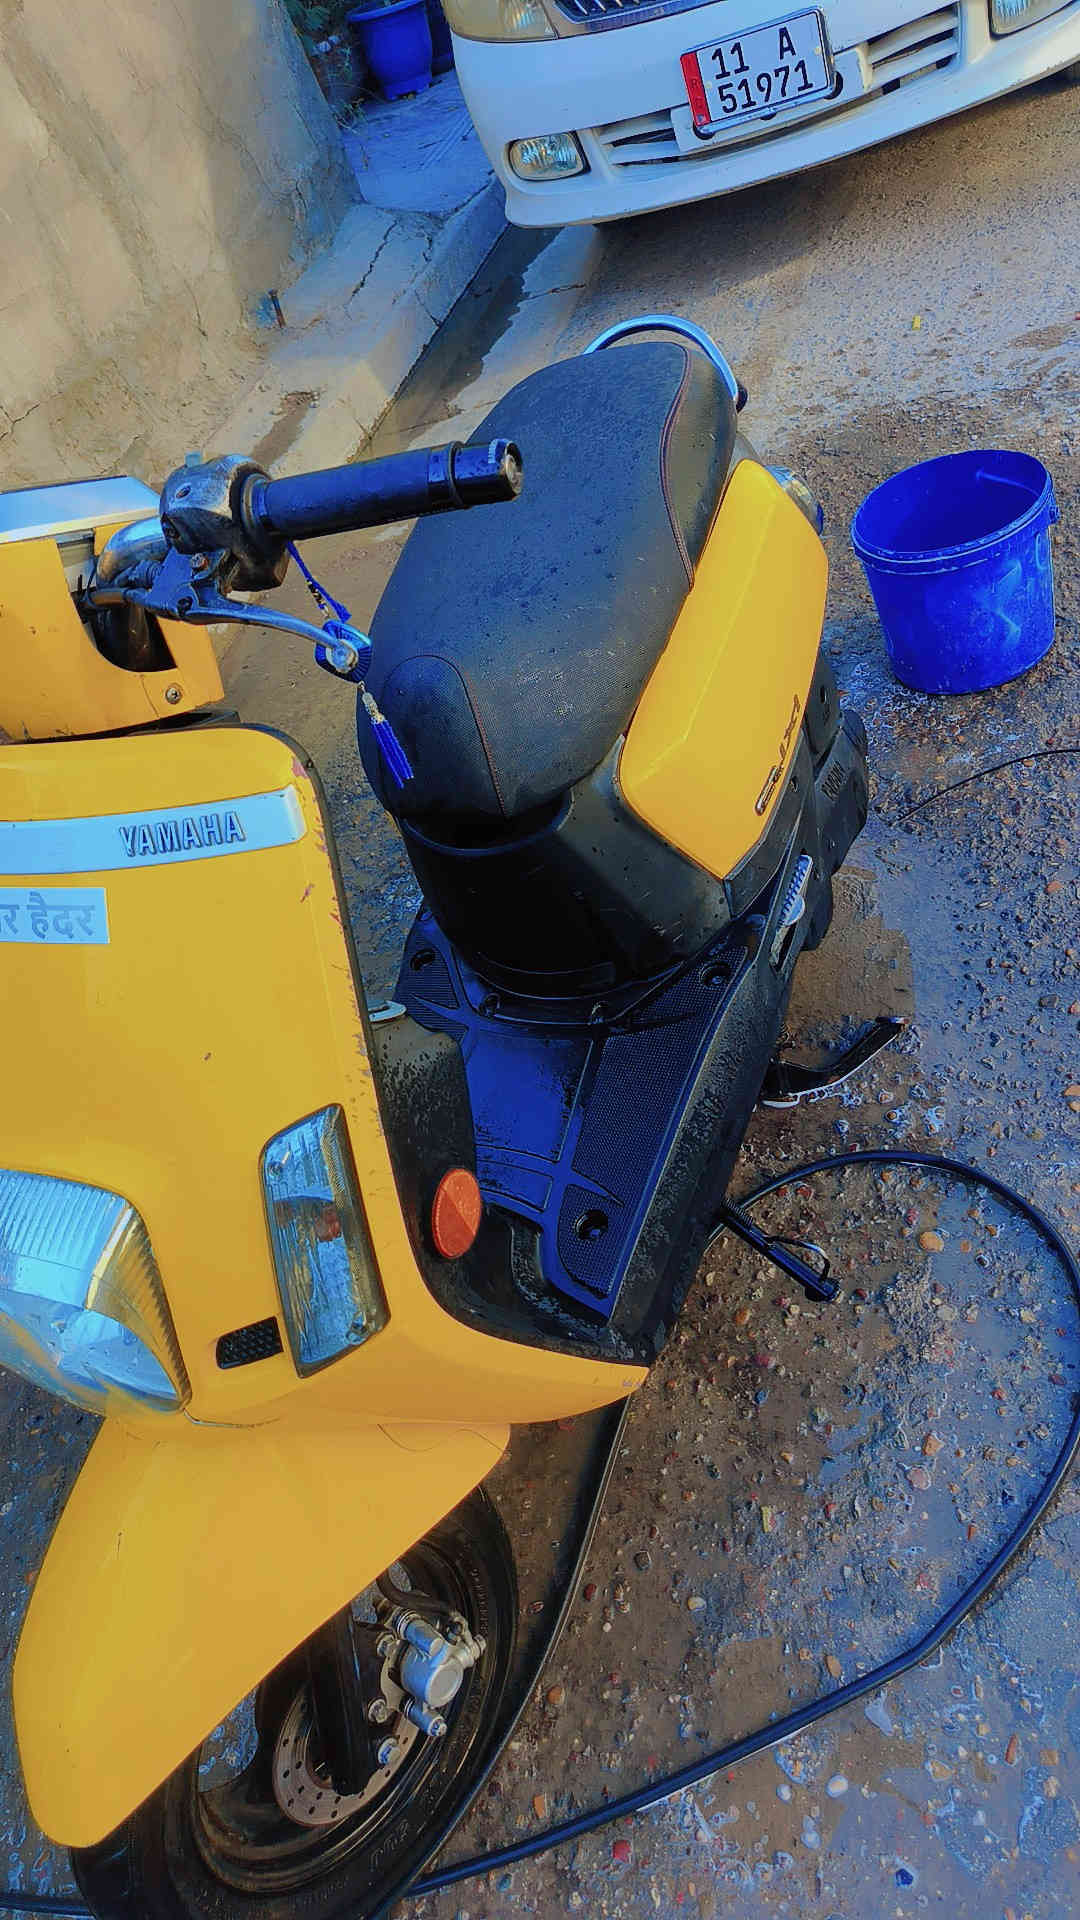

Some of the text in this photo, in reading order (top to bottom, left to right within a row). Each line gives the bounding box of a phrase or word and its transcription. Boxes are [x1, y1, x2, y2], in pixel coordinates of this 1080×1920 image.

[711, 26, 797, 80] 11 A
[717, 59, 814, 114] 51971
[118, 810, 248, 858] YAMAHA
[0, 902, 20, 936] र
